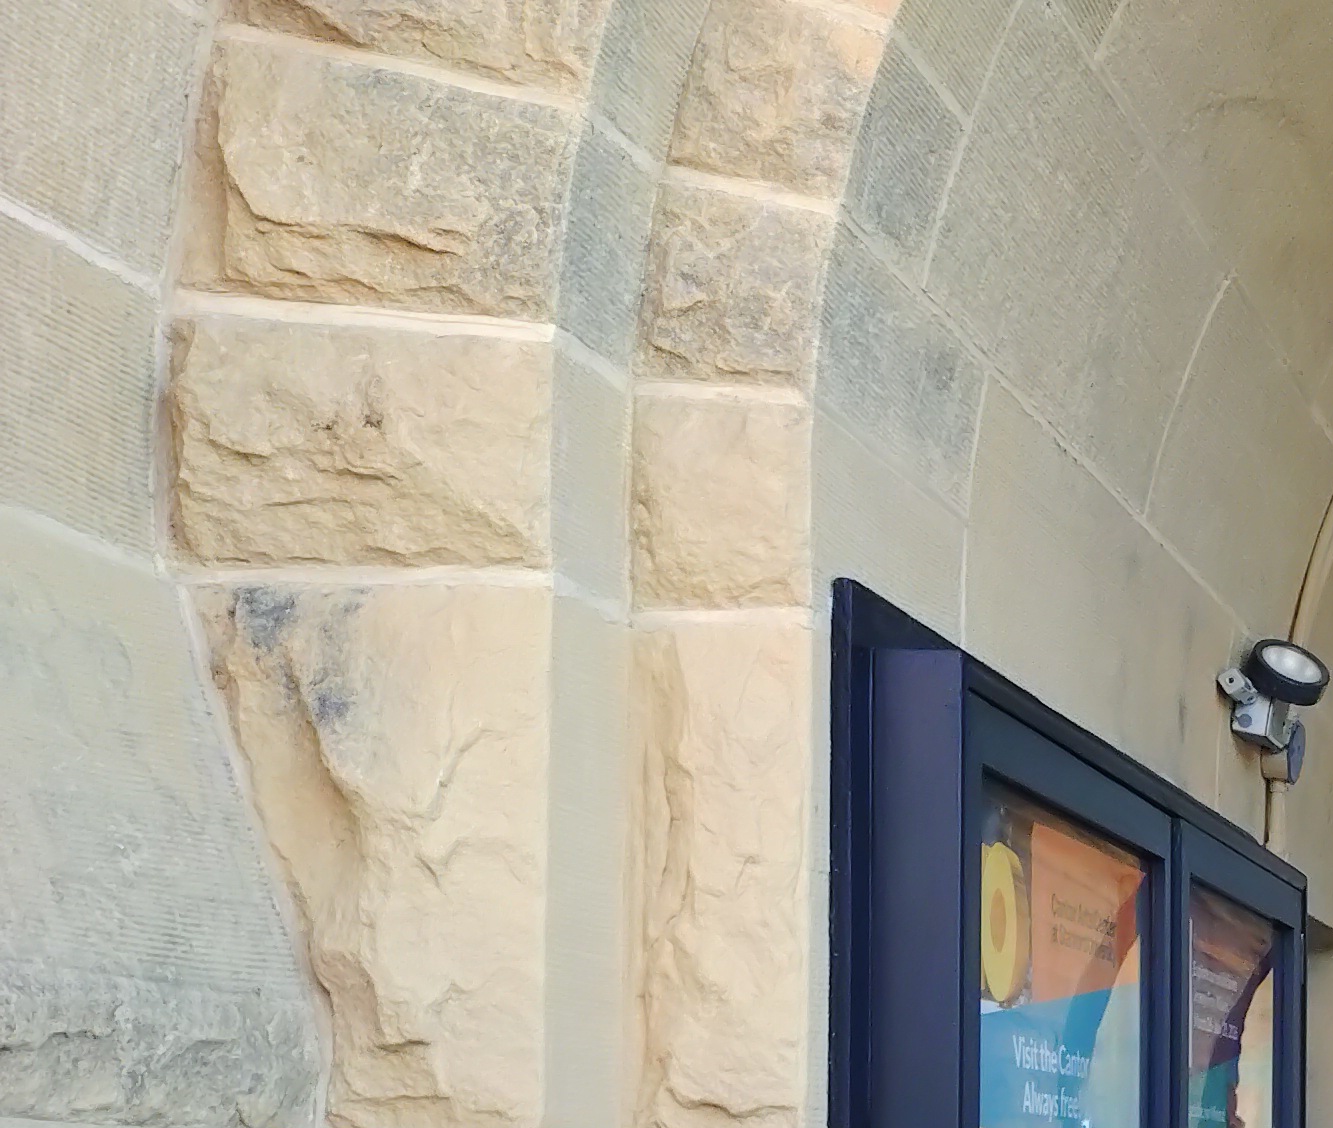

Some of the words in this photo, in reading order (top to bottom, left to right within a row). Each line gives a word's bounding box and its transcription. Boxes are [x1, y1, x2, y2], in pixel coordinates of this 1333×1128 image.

[1013, 1035, 1039, 1070] Visit
[1040, 1039, 1058, 1074] the
[1023, 1081, 1059, 1122] Always
